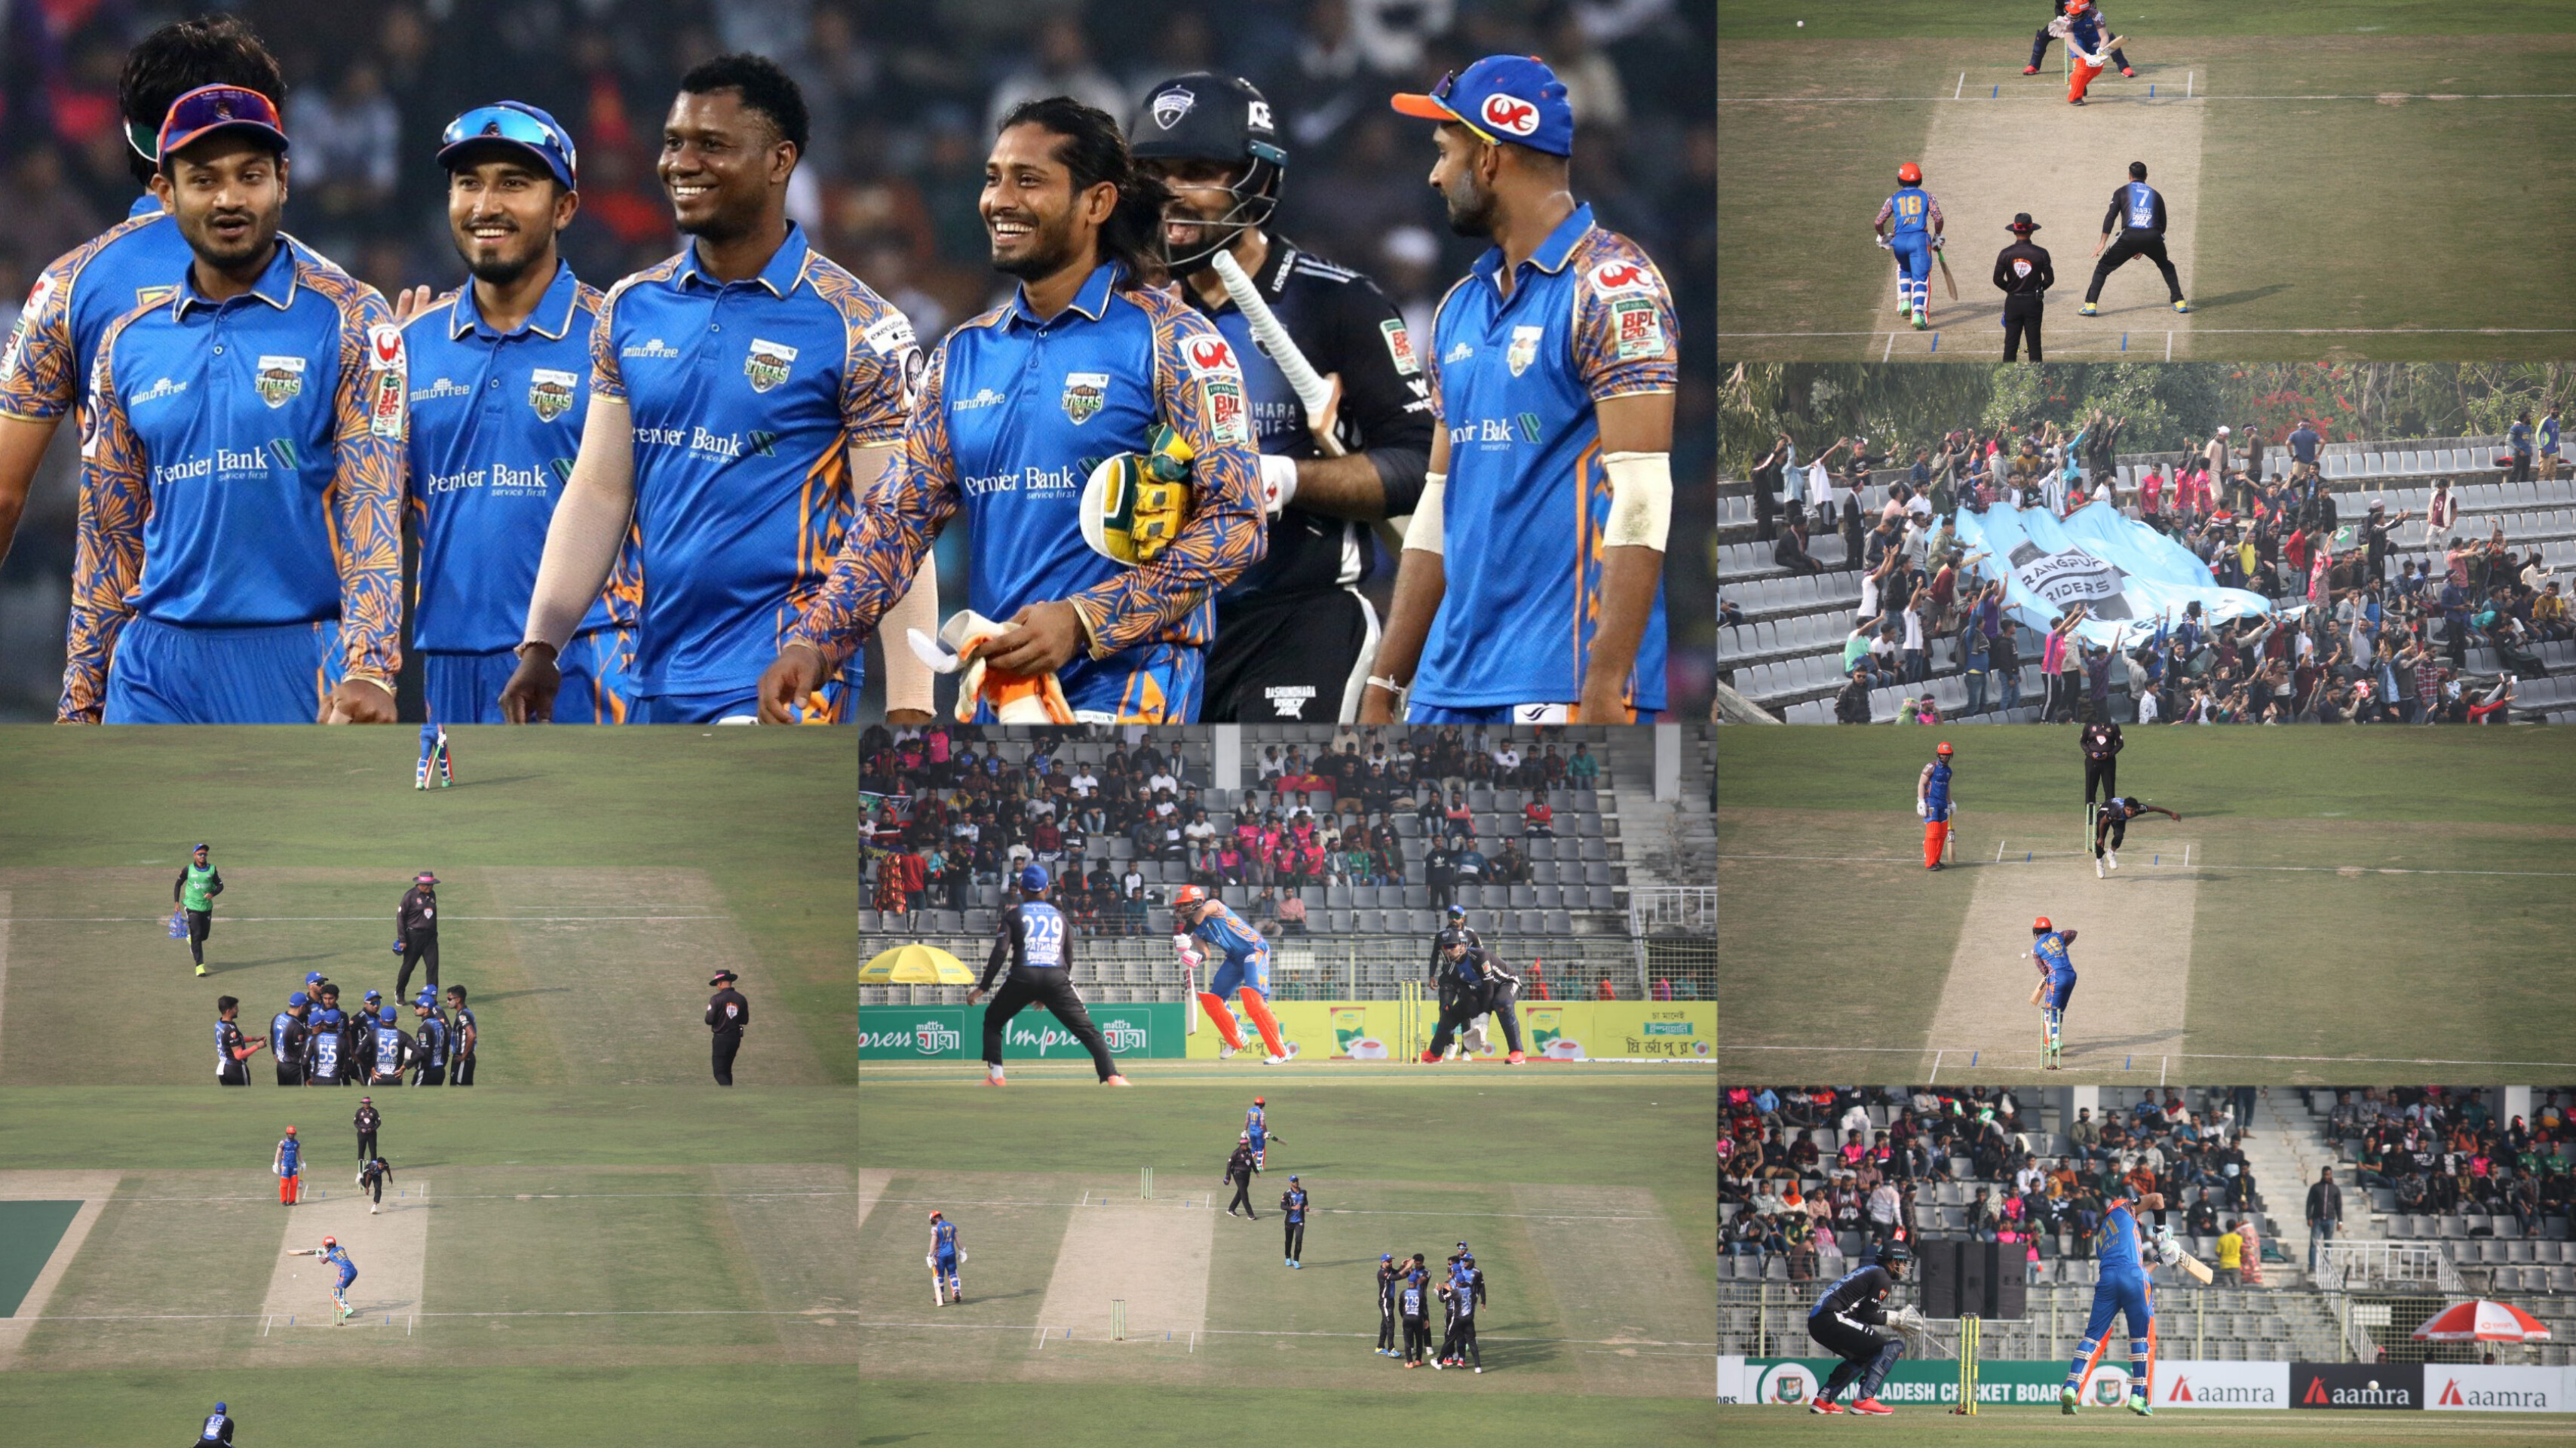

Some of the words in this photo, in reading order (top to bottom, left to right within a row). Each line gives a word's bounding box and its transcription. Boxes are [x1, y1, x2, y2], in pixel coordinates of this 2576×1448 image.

[1897, 195, 1921, 216] 18
[2136, 189, 2149, 206] 7
[1622, 311, 1655, 328] BPL
[747, 360, 789, 382] TIGERS
[256, 375, 301, 394] TIGERS
[529, 388, 572, 410] TIGERS
[1063, 393, 1103, 410] TIGERS
[631, 422, 685, 446] emier
[690, 425, 743, 457] Bank
[155, 455, 211, 485] Pemier
[216, 446, 268, 471] Bank
[428, 465, 486, 495] Pemier
[492, 464, 547, 488] Bank
[965, 469, 1020, 496] Prmier
[1025, 465, 1077, 490] Bank
[2046, 580, 2110, 602] RIDERS
[1021, 915, 1063, 944] 229
[2041, 937, 2063, 956] 18
[916, 1021, 944, 1031] mattra
[1103, 1019, 1131, 1029] mattra
[378, 1037, 399, 1057] 56
[1006, 1018, 1082, 1057] Impre
[319, 1043, 337, 1064] 55
[377, 1055, 397, 1063] BABAR
[1979, 1109, 1994, 1124] 4
[1404, 1296, 1420, 1308] 229
[1837, 1382, 1936, 1401] ANLADESH
[1940, 1383, 2012, 1401] CRCKET
[2016, 1383, 2064, 1402] BOAR
[2197, 1386, 2275, 1403] aamra
[2332, 1387, 2410, 1405] aamra
[2468, 1390, 2547, 1407] aamra
